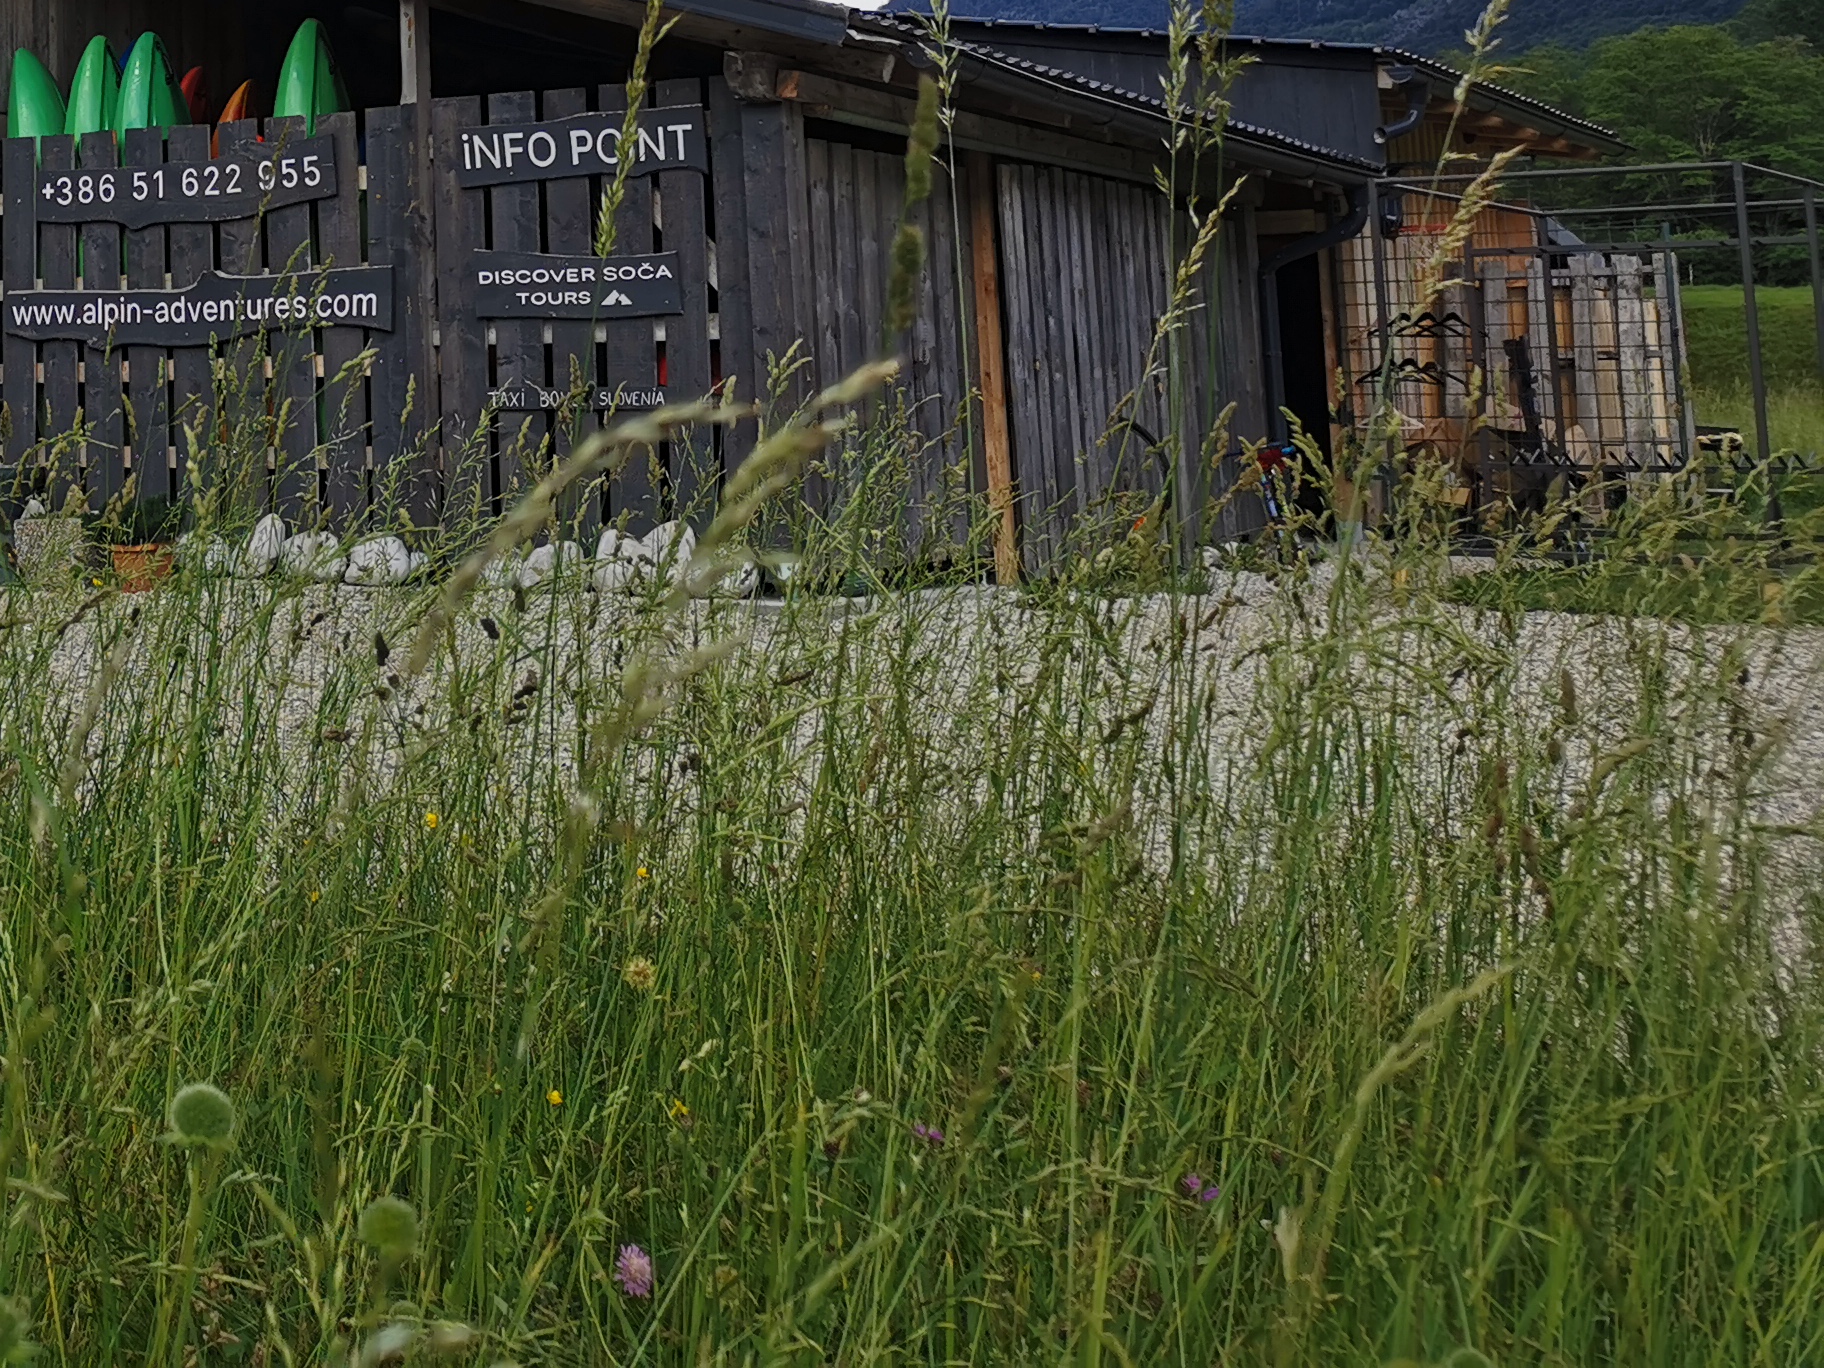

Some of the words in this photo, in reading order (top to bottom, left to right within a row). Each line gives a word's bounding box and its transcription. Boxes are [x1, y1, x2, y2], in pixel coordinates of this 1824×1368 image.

[41, 173, 116, 206] +386
[132, 169, 164, 201] 51
[181, 163, 242, 197] 622
[257, 155, 321, 191] 955
[478, 266, 596, 285] DISCOVER
[602, 262, 674, 282] SOČA
[516, 291, 592, 306] TOURS
